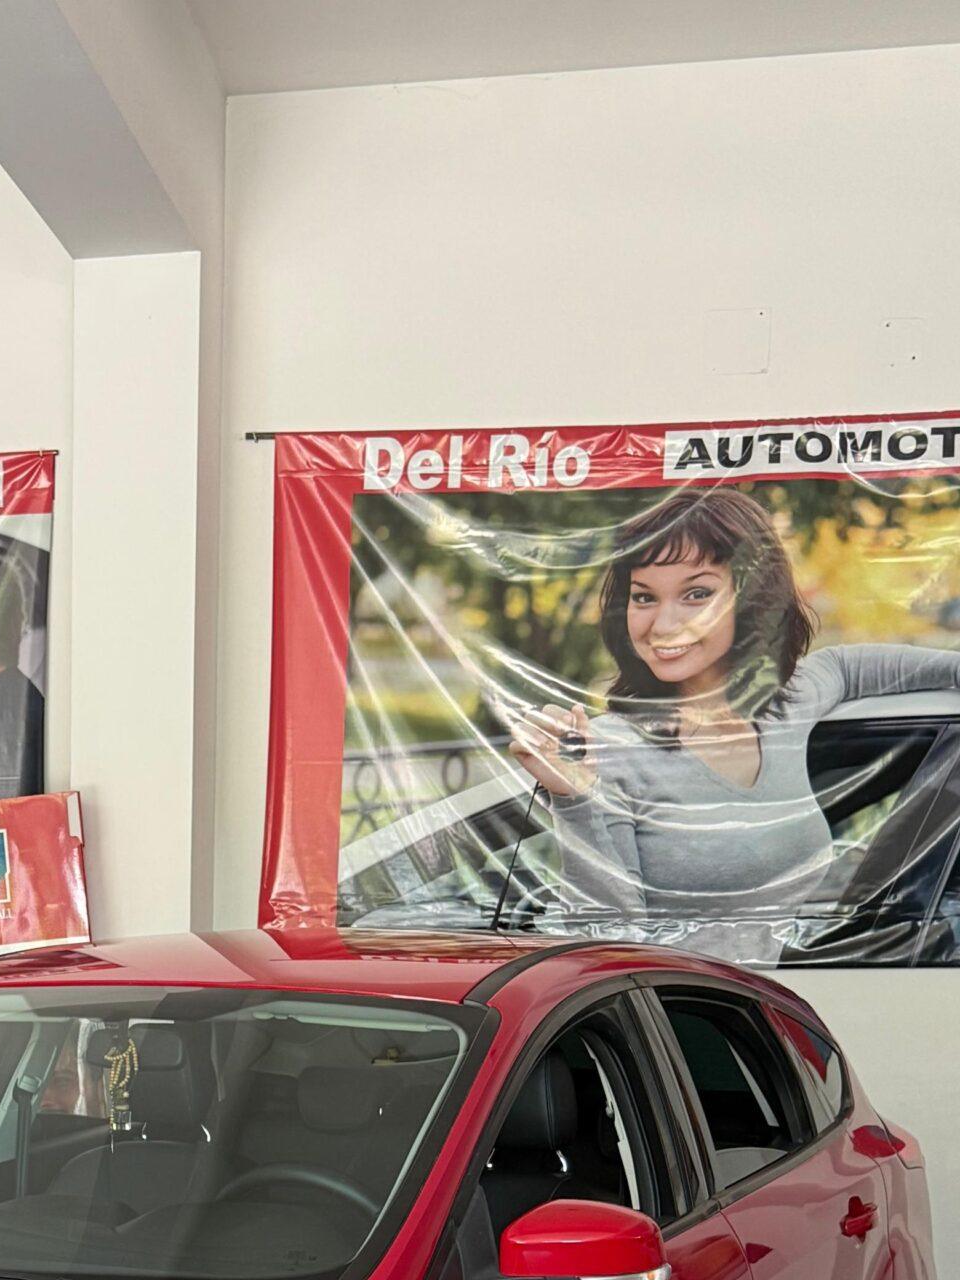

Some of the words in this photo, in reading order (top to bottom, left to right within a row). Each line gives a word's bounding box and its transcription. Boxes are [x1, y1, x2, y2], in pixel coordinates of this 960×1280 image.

[363, 434, 464, 491] Del
[488, 430, 590, 488] Río
[673, 426, 960, 470] AUTOMOT
